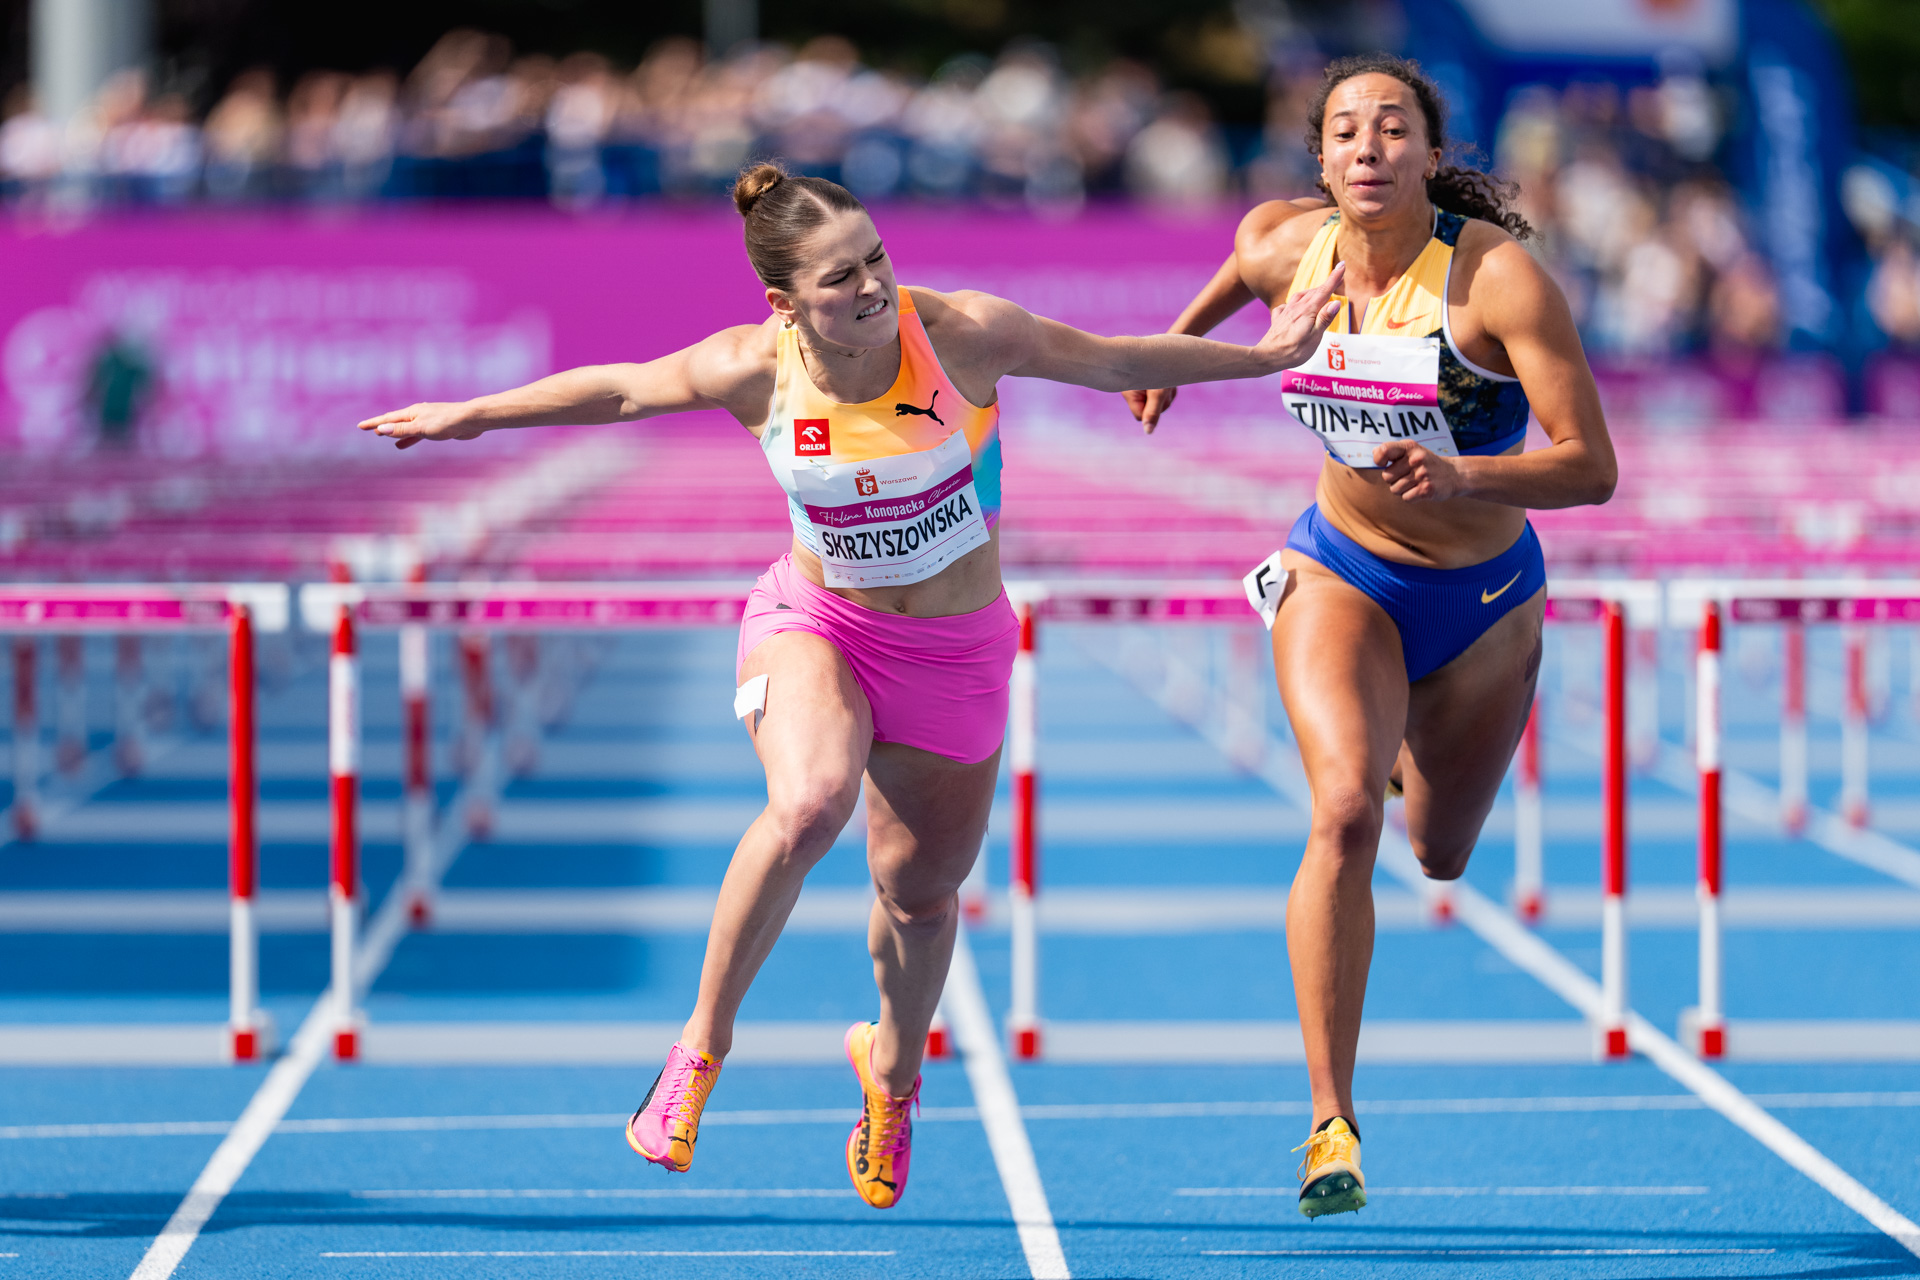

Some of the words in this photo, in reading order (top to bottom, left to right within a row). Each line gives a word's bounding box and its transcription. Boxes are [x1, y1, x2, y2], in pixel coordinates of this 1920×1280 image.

[1347, 357, 1381, 366] Warszawa
[1291, 377, 1331, 393] Halina
[1331, 380, 1385, 401] Konopacka
[1386, 386, 1424, 401] Classic
[799, 443, 826, 451] ORLEN
[879, 475, 918, 486] Warszawa
[819, 510, 863, 526] Halina
[864, 499, 926, 519] Konopacka
[822, 493, 973, 561] SKRZYSZOWSKA
